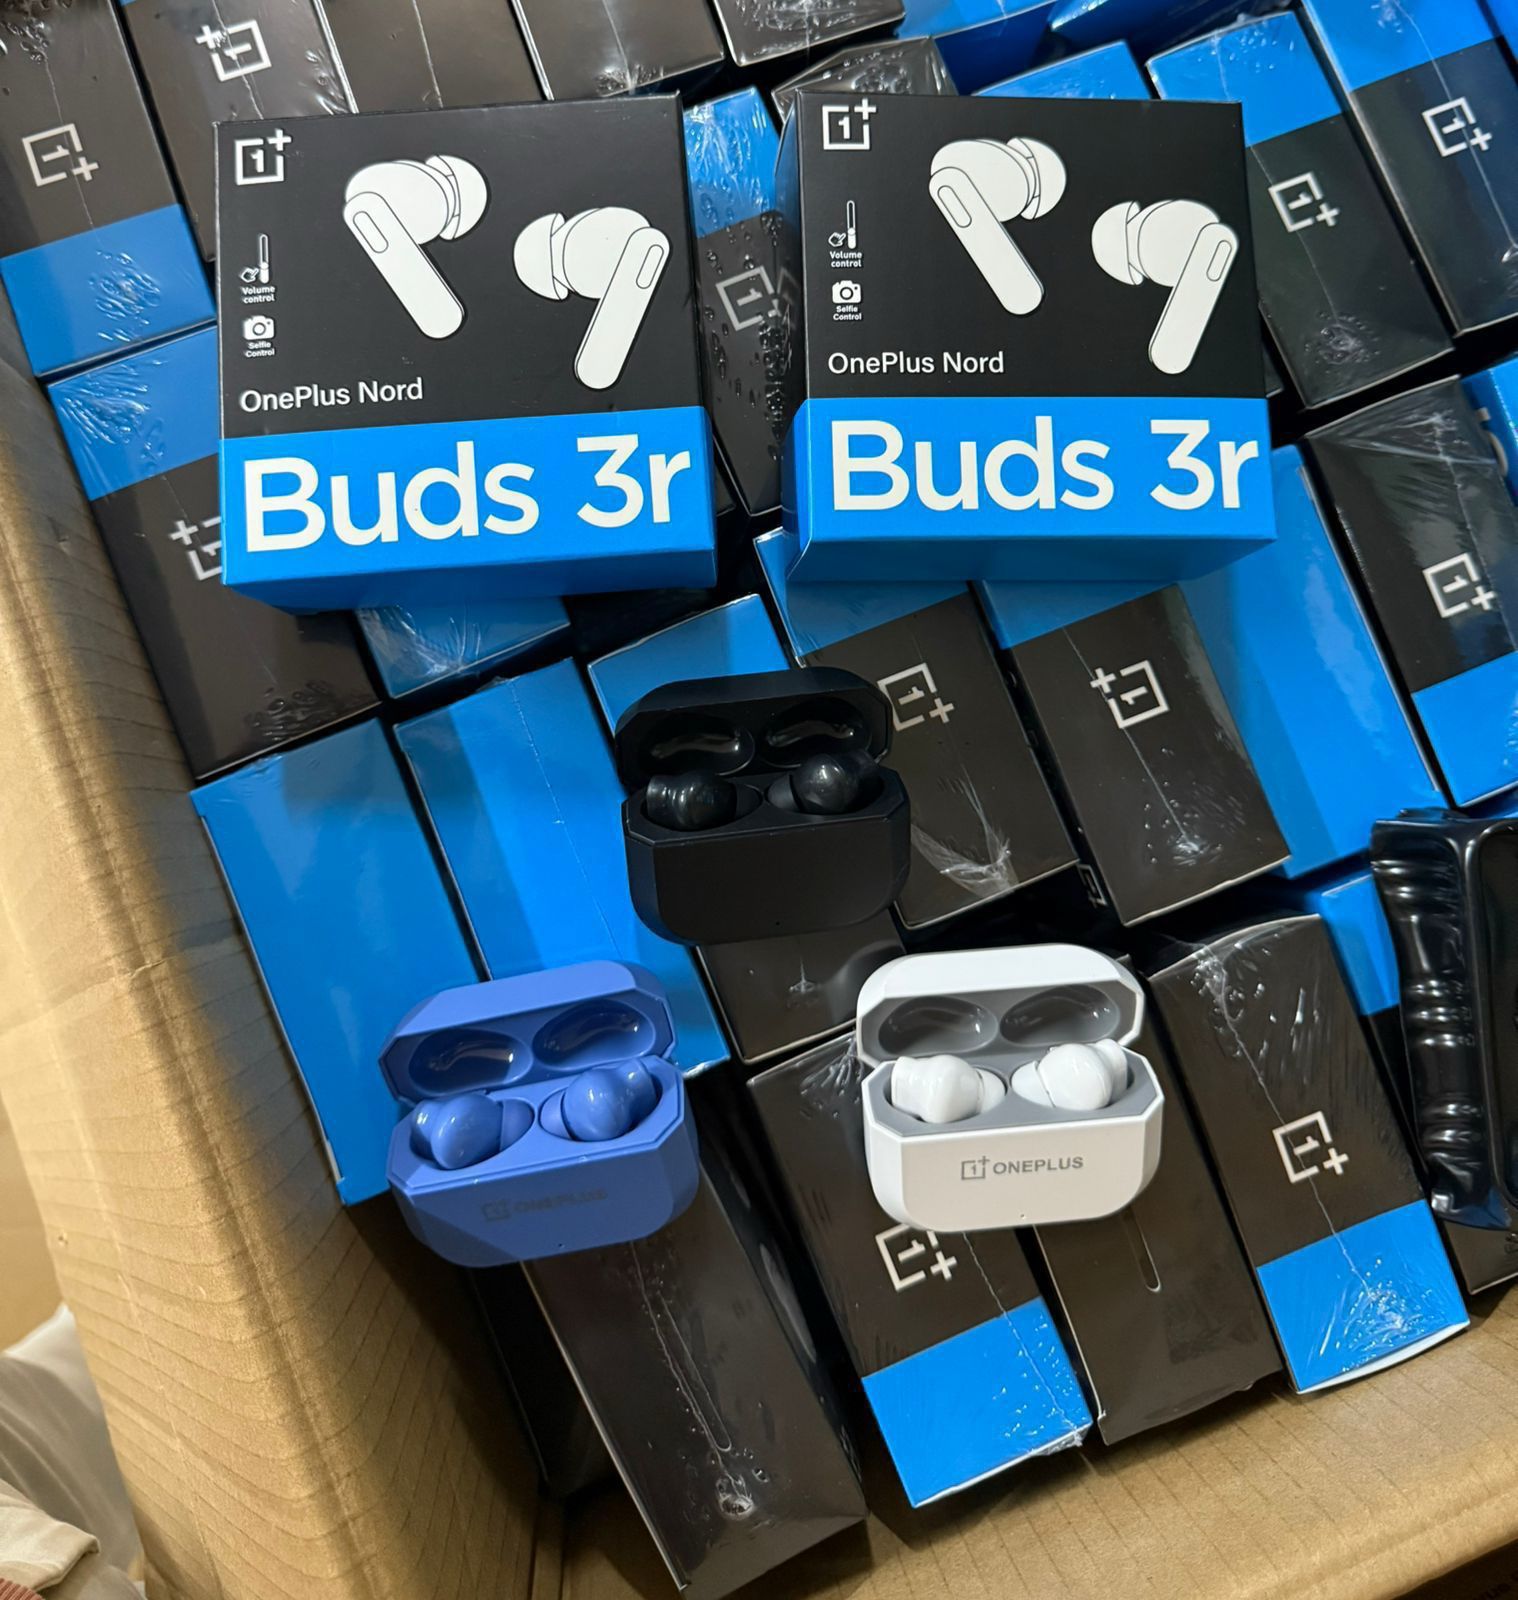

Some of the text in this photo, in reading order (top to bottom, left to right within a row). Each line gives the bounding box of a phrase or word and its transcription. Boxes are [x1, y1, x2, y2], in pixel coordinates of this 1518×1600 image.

[829, 251, 863, 260] Volume
[830, 259, 862, 268] control
[241, 285, 276, 295] Volume
[242, 294, 275, 304] control
[836, 305, 858, 313] Selfie
[833, 312, 862, 321] Control
[247, 340, 271, 350] Selfie
[245, 348, 275, 358] Control
[828, 350, 1005, 374] OnePlus Nord
[239, 377, 424, 413] OnePlus Nord
[831, 415, 1259, 511] Buds 3r
[244, 434, 691, 552] Buds 3r
[992, 1156, 1084, 1175] ONEPLUS
